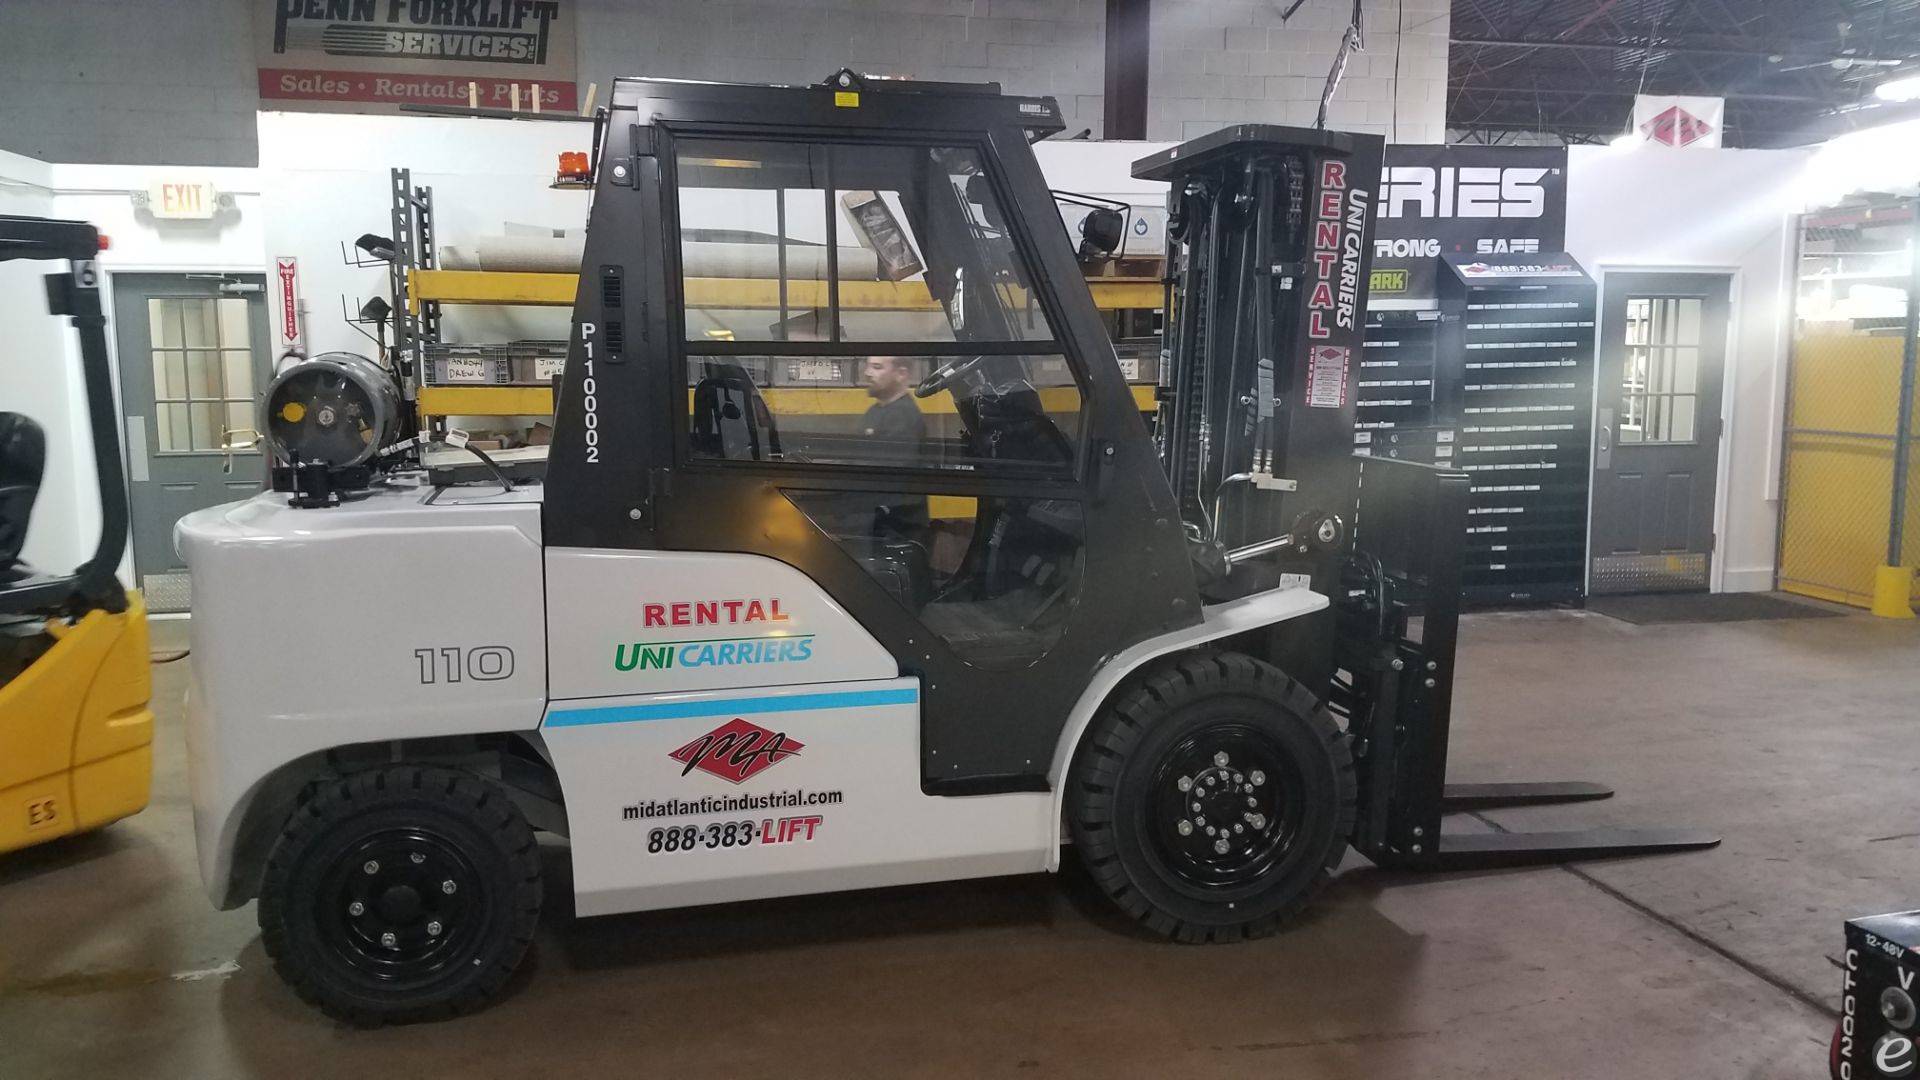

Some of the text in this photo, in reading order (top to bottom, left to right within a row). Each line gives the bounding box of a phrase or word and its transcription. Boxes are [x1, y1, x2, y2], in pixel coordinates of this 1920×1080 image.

[384, 31, 528, 59] SERVICES
[386, 0, 558, 64] FORKLIFT
[280, 75, 349, 93] Sales
[374, 78, 468, 99] Rentals
[162, 183, 202, 212] EXIT
[1377, 166, 1550, 218] RIES
[1309, 161, 1346, 338] RENTAL
[1476, 238, 1540, 254] SAFE
[581, 322, 599, 463] P1100002
[642, 599, 790, 629] RENTAL
[415, 645, 515, 684] 110
[623, 789, 843, 820] midatlanticindustrial.com
